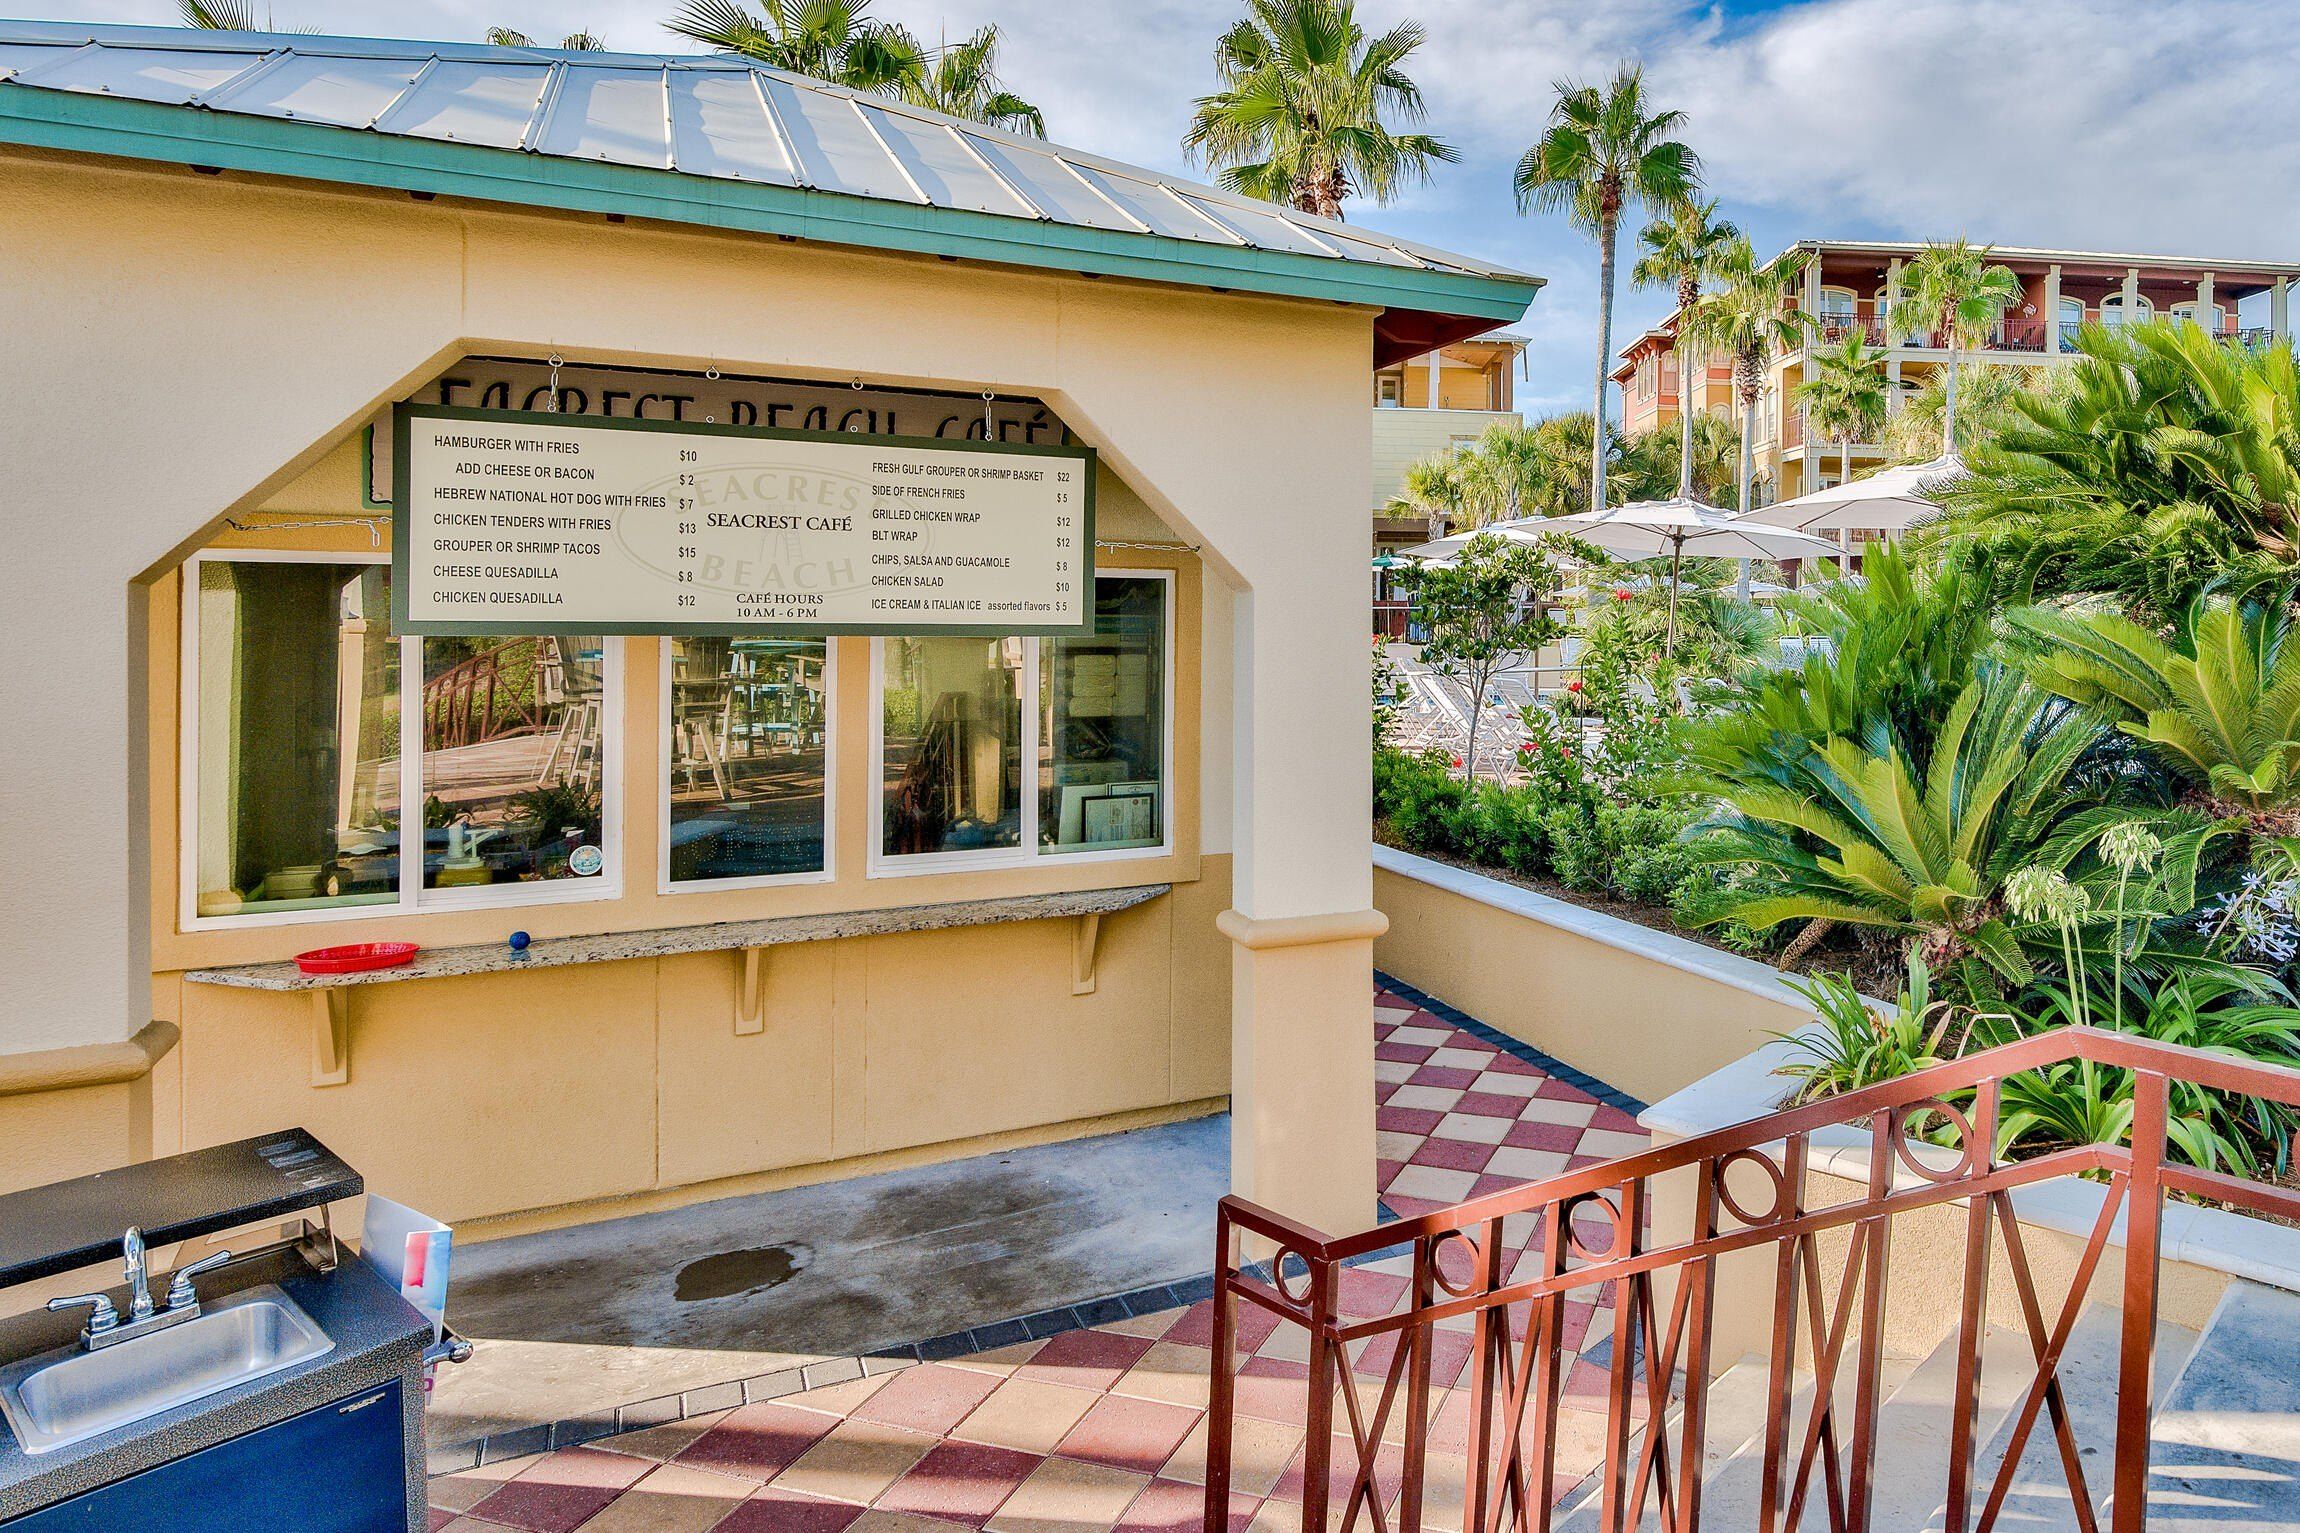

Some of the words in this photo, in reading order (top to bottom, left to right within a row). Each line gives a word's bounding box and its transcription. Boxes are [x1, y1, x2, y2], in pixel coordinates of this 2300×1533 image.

[434, 434, 512, 451] HAMBURGER
[514, 439, 544, 453] WITH
[546, 441, 580, 455] FRIES
[679, 449, 697, 462] $10
[455, 462, 481, 475] ADD
[484, 463, 532, 477] CHEESE
[534, 466, 552, 478] OR
[554, 467, 595, 480] BACON
[872, 462, 900, 474] FRESH
[901, 463, 925, 475] GULF
[925, 465, 966, 478] GROUPER
[967, 467, 980, 479] OR
[981, 468, 1012, 480] SHRIMP
[1012, 469, 1044, 482] BASKET
[1057, 471, 1070, 483] $22
[434, 487, 487, 501] HEBREW
[489, 489, 548, 503] NATIONAL
[550, 491, 574, 504] HOT
[576, 493, 602, 506] DOG
[604, 494, 632, 507] WITH
[635, 495, 666, 508] FRIES
[871, 484, 892, 496] SIDE
[893, 485, 905, 497] OF
[906, 486, 940, 499] FRENCH
[941, 488, 966, 500] FRIES
[433, 513, 487, 527] CHICKEN
[490, 515, 545, 529] TENDERS
[547, 517, 576, 529] WITH
[579, 518, 612, 531] FRIES
[706, 512, 802, 530] SEACREST
[805, 515, 853, 532] CAFÉ
[872, 508, 912, 521] GRILLED
[913, 510, 953, 522] CHICKEN
[954, 511, 981, 523] WRAP
[1056, 516, 1071, 527] $12
[678, 522, 697, 535] $13
[872, 529, 889, 541] BLT
[890, 530, 918, 542] WRAP
[433, 538, 493, 553] GROUPER
[495, 540, 514, 553] OR
[516, 541, 560, 554] SHRIMP
[562, 542, 601, 555] TACOS
[1056, 536, 1071, 548] $12
[678, 545, 696, 559] $15
[871, 553, 902, 567] CHIPS,
[903, 554, 934, 566] SALSA
[934, 555, 954, 567] AND
[955, 556, 1010, 568] GUACAMOLE
[433, 565, 482, 578] CHEESE
[484, 566, 559, 579] QUESADILLA
[700, 553, 856, 589] BEACH
[871, 575, 912, 587] CHICKEN
[913, 576, 944, 587] SALAD
[1055, 581, 1070, 593] $10
[432, 591, 486, 604] CHICKEN
[489, 591, 564, 604] QUESADILLA
[677, 594, 696, 607] $12
[736, 591, 772, 604] CAFÉ
[774, 593, 824, 605] HOURS
[871, 598, 887, 609] ICE
[888, 598, 921, 610] CREAM
[931, 599, 965, 610] ITALIAN
[966, 600, 981, 611] ICE
[737, 607, 751, 618] 10
[753, 607, 776, 618] AM
[796, 608, 817, 618] PM
[987, 601, 1023, 611] assorted
[1023, 600, 1051, 611] flavors
